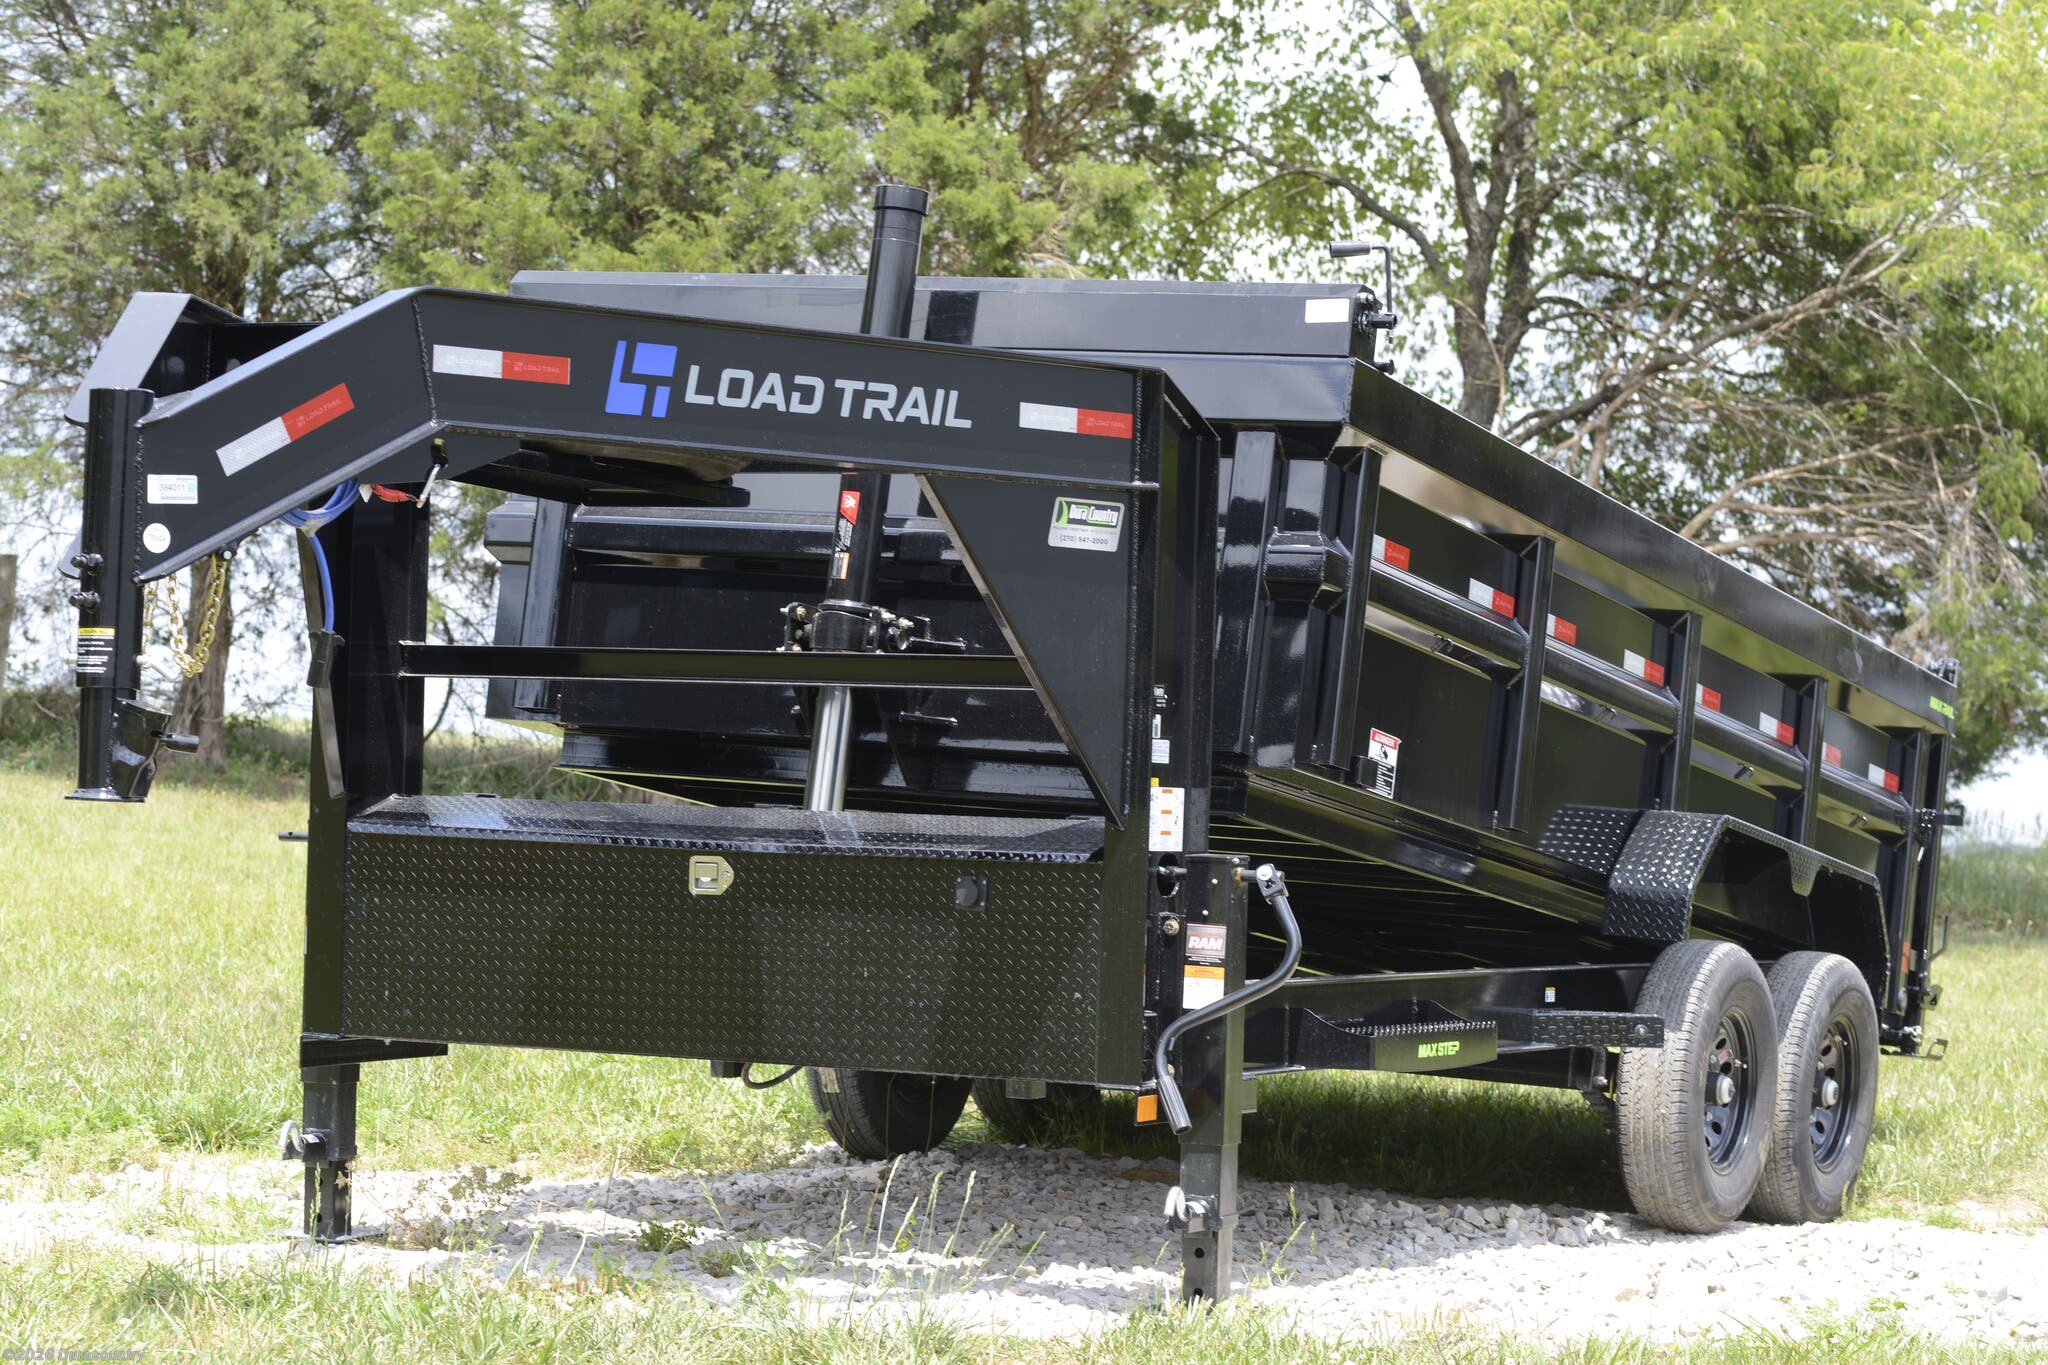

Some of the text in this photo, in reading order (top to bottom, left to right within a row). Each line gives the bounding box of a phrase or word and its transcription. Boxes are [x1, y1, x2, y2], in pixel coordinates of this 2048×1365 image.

[684, 365, 972, 429] LOAD TRAIL
[1188, 935, 1224, 951] RAM
[1417, 1040, 1460, 1058] MAX STEP
